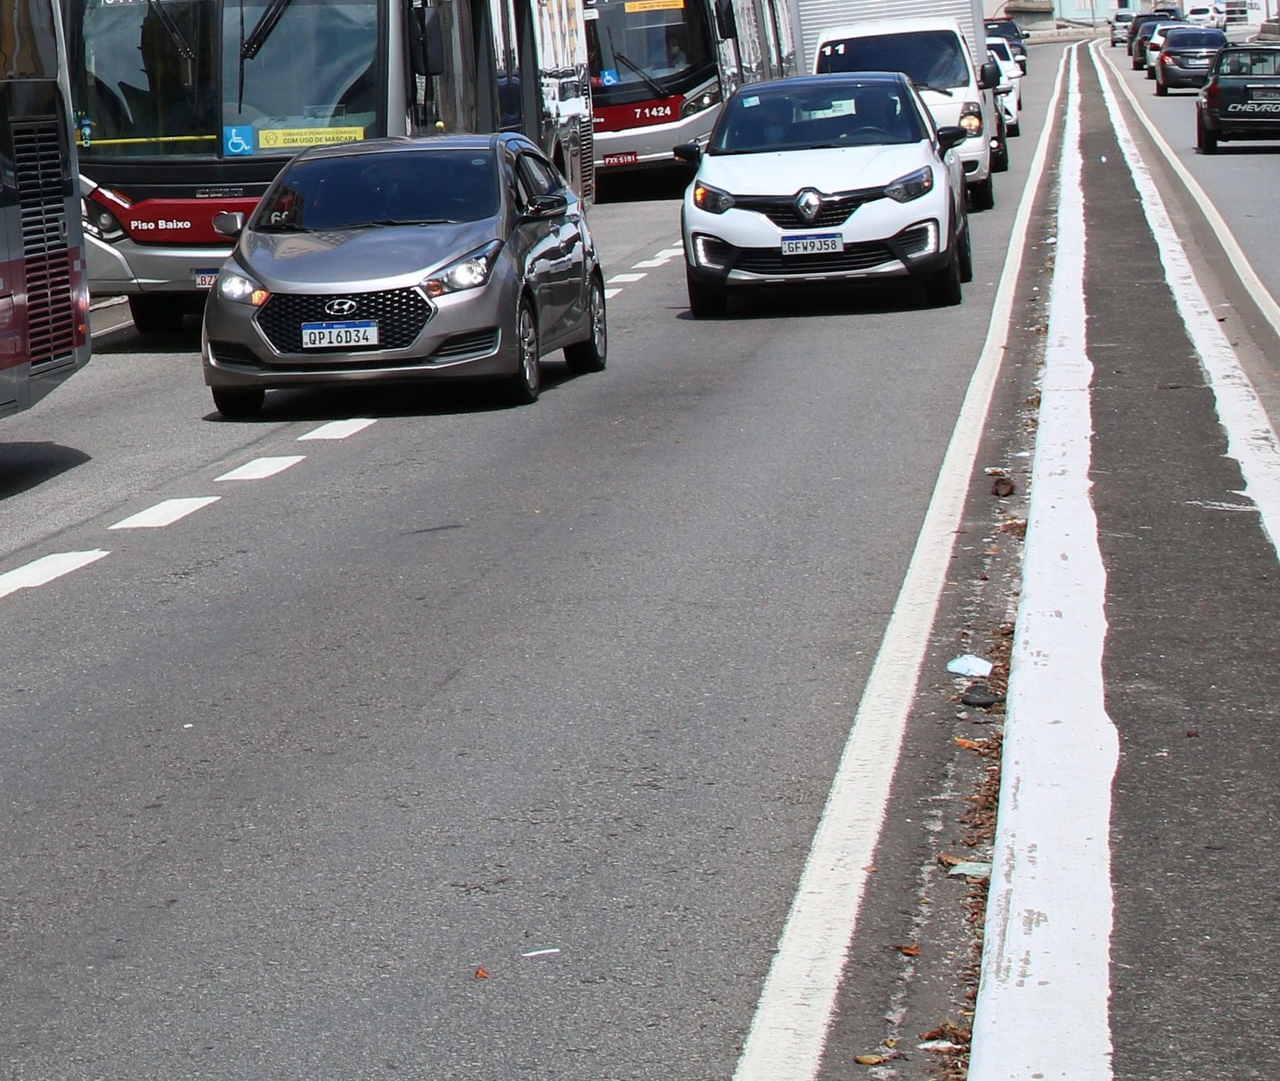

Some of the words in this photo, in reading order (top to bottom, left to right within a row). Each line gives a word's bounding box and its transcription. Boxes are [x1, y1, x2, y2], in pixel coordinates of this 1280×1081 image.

[634, 108, 642, 118] 7
[644, 106, 671, 118] 1424
[130, 220, 155, 230] Piso
[158, 219, 191, 230] Baixo
[787, 239, 837, 253] GFW9J58
[308, 329, 369, 345] QPI6D34
